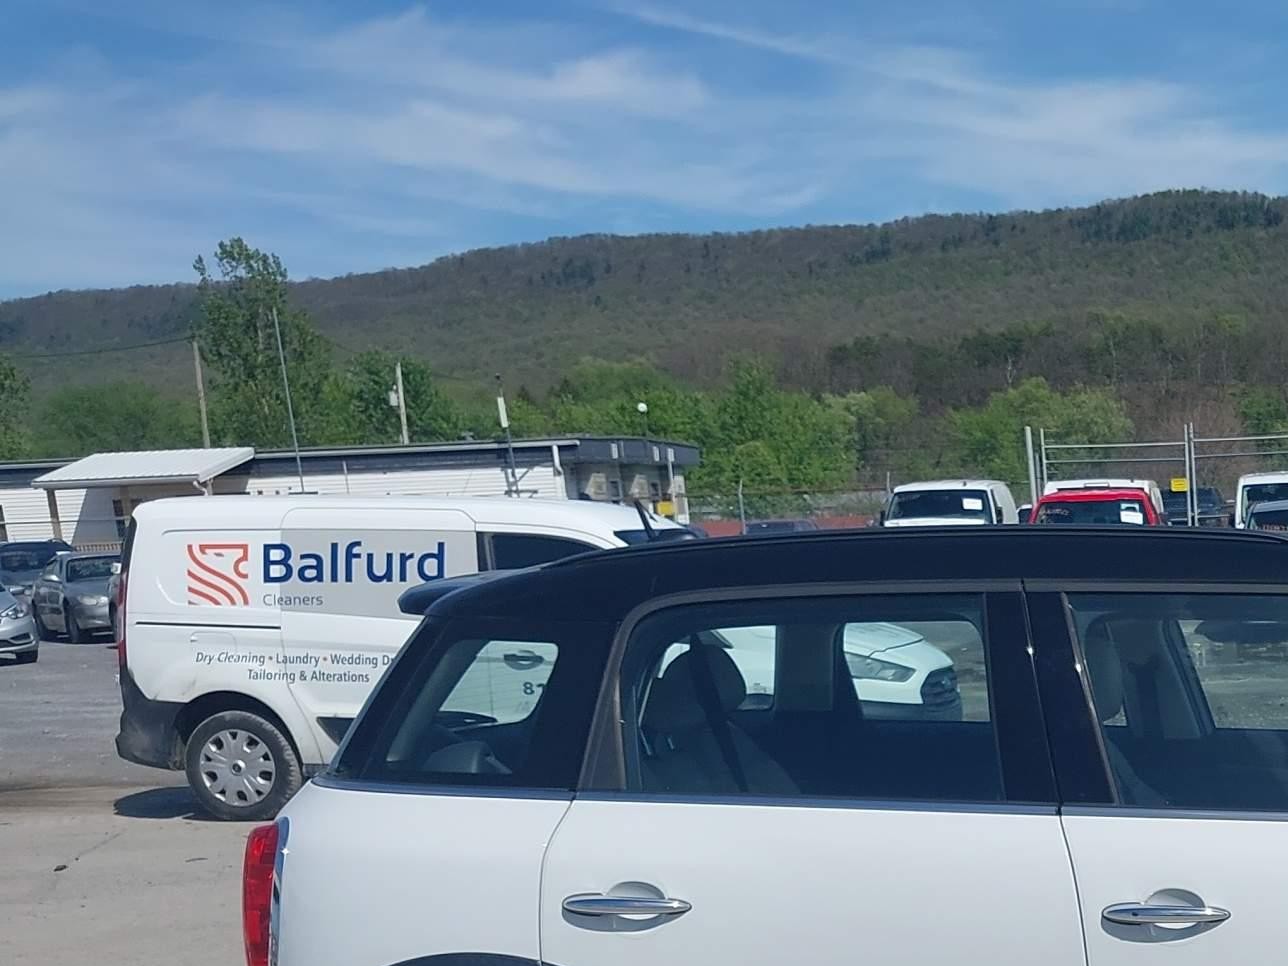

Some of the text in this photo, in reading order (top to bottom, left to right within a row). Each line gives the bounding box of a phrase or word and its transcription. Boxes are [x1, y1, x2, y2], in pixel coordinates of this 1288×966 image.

[262, 541, 446, 584] Balfurd
[263, 593, 324, 607] Cleaners
[195, 652, 215, 665] Dry
[217, 651, 266, 667] Cleaning
[276, 652, 320, 668] Laundry
[330, 653, 378, 669] Wedding
[248, 669, 370, 684] Tailoring & Alterations
